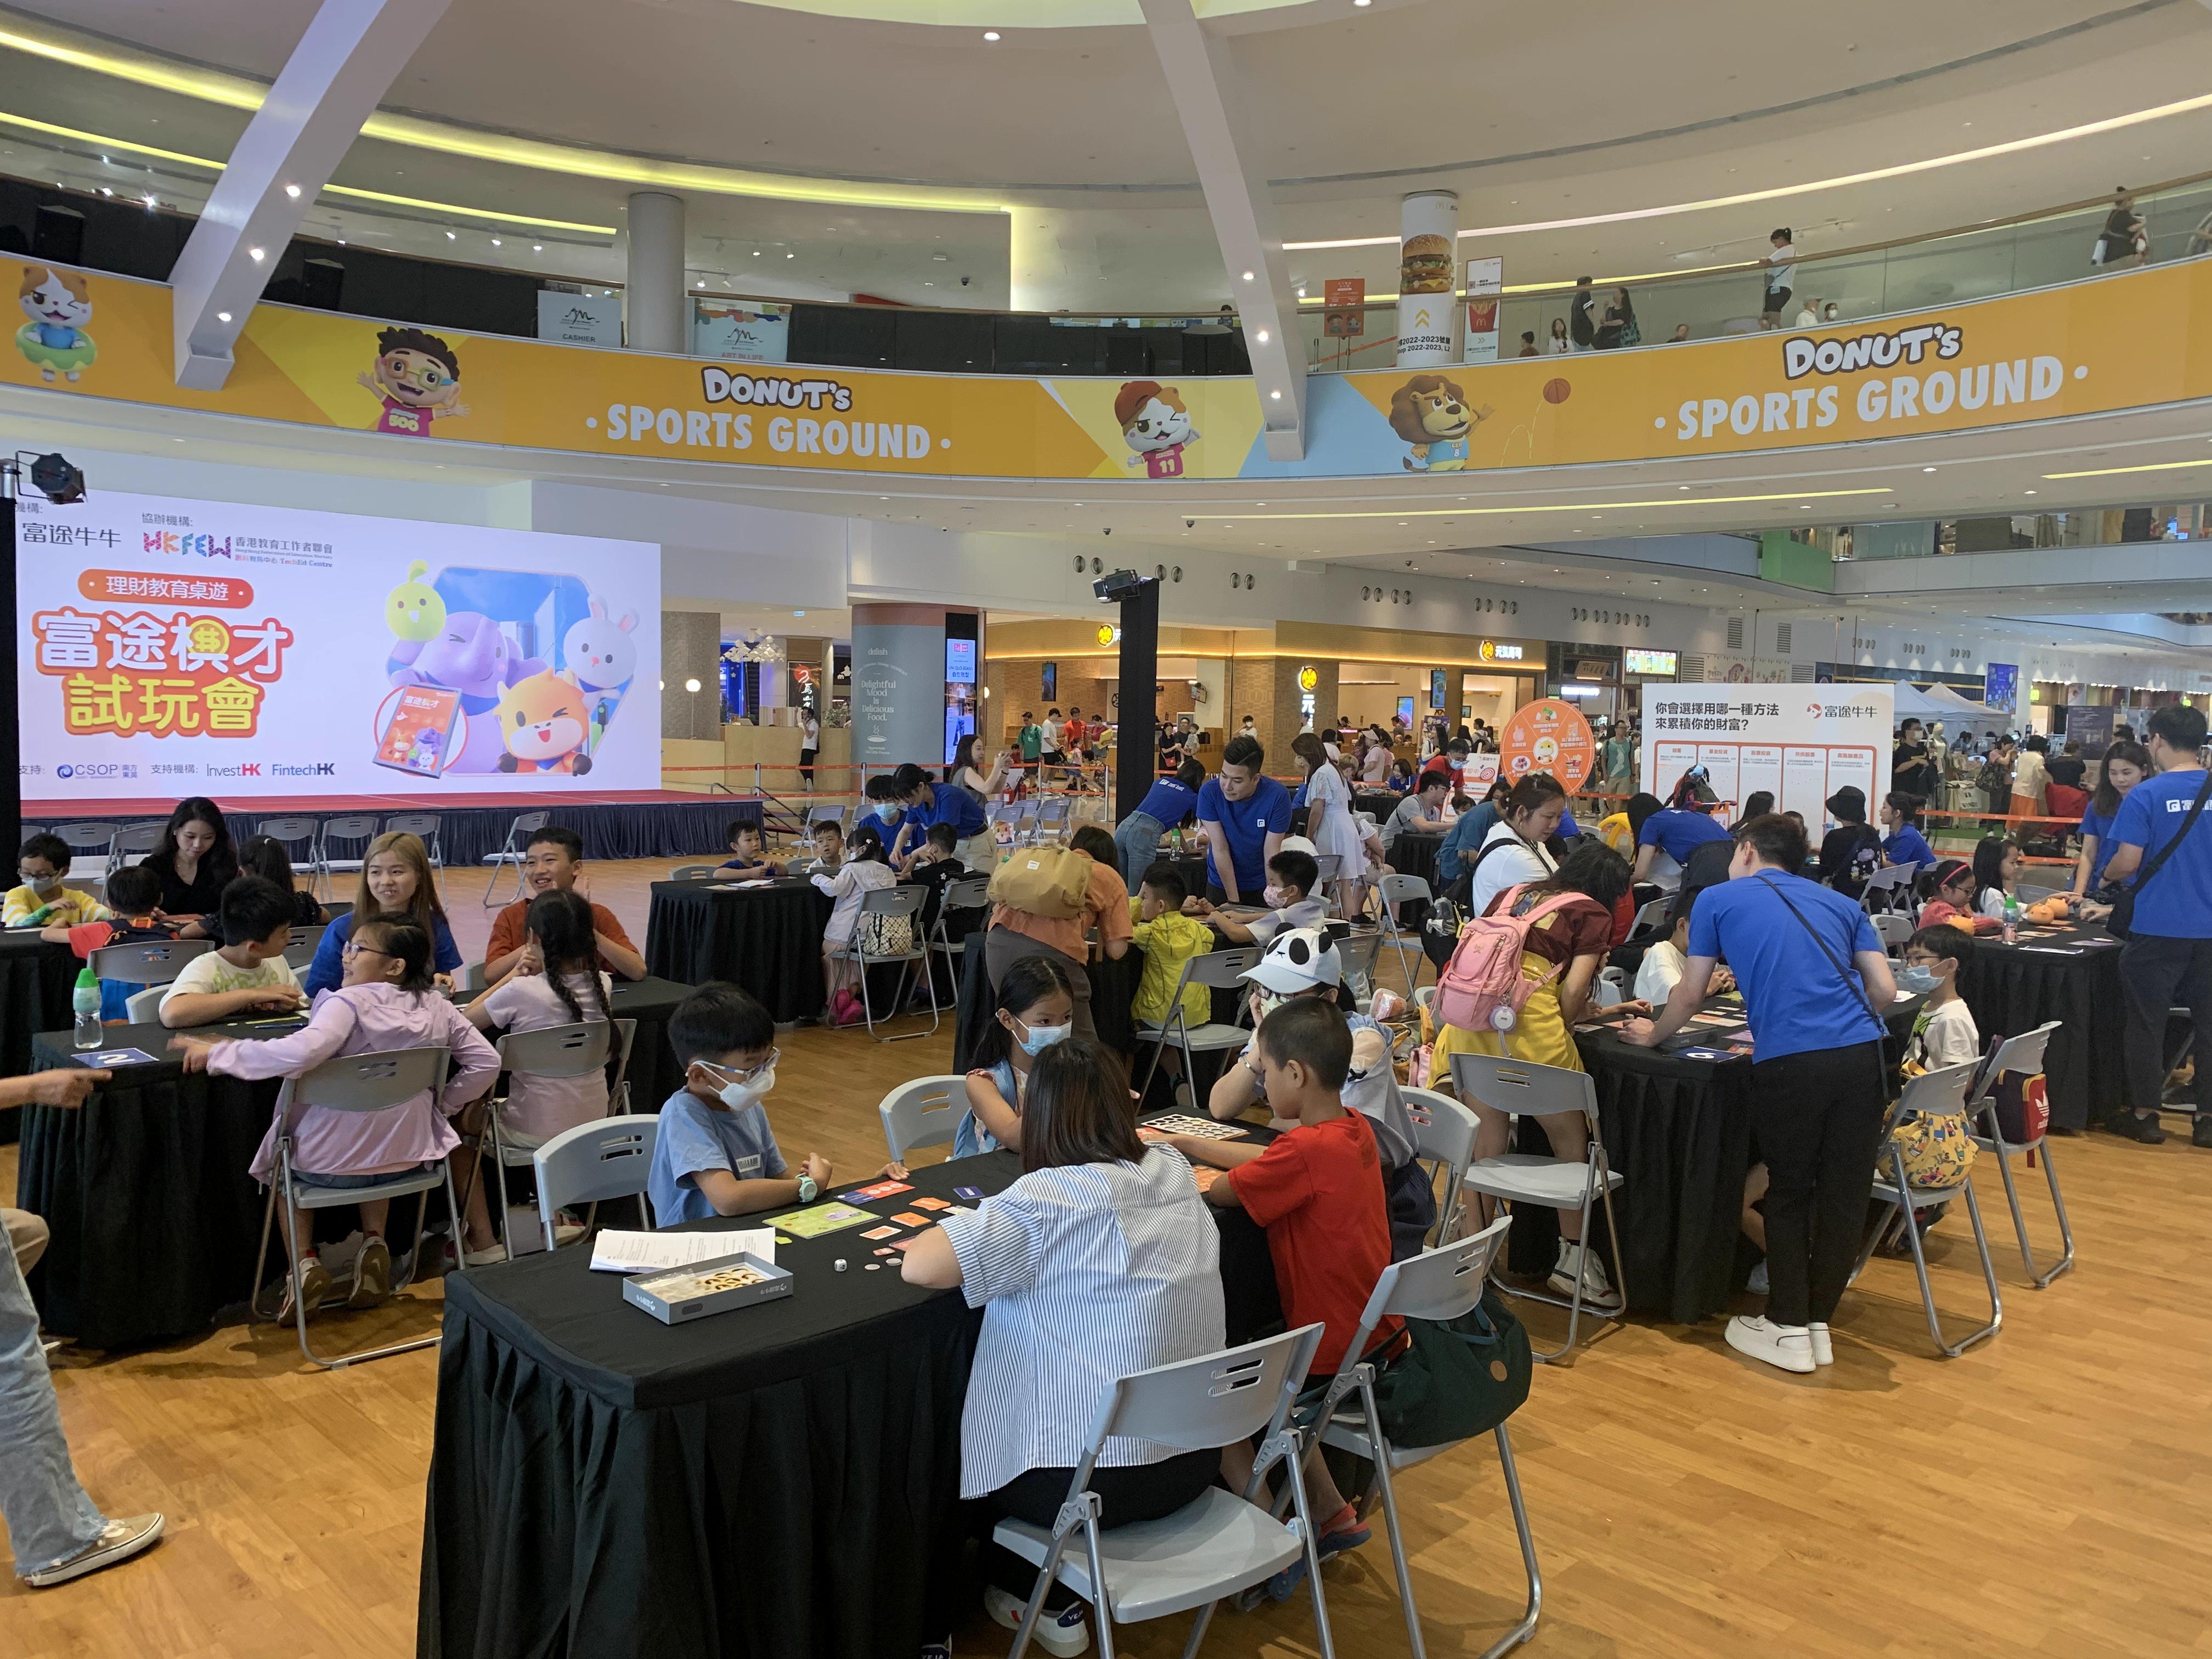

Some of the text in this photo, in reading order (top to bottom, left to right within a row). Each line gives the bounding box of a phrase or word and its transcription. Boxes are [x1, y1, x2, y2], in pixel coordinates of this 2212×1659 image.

[563, 334, 595, 342] CASHIER
[1678, 356, 2063, 439] SPORTS GROUND
[389, 414, 420, 432] 500
[607, 404, 930, 459] SPORTS GROUND
[1454, 449, 1459, 457] 8
[1159, 459, 1175, 473] 11
[142, 512, 193, 527] 協辦機構:
[22, 522, 121, 548] 富途牛牛
[143, 530, 231, 559] HKFEW
[236, 536, 332, 554] 香港教育工作者聯會
[106, 575, 229, 601] 理財教育桌遊
[38, 610, 287, 674] 富途棋才
[861, 680, 896, 690] Delightful
[68, 673, 259, 730] 試玩會
[862, 704, 894, 714] Delicious
[1655, 702, 1779, 716] 你會選擇用哪一種方法
[1825, 706, 1877, 718] 富途牛牛
[1655, 718, 1749, 731] 來累積你的財富?
[75, 764, 119, 775] CSOP
[150, 764, 198, 774] 支持機構:
[207, 763, 262, 776] InvestHK
[272, 763, 335, 776] FintechHK
